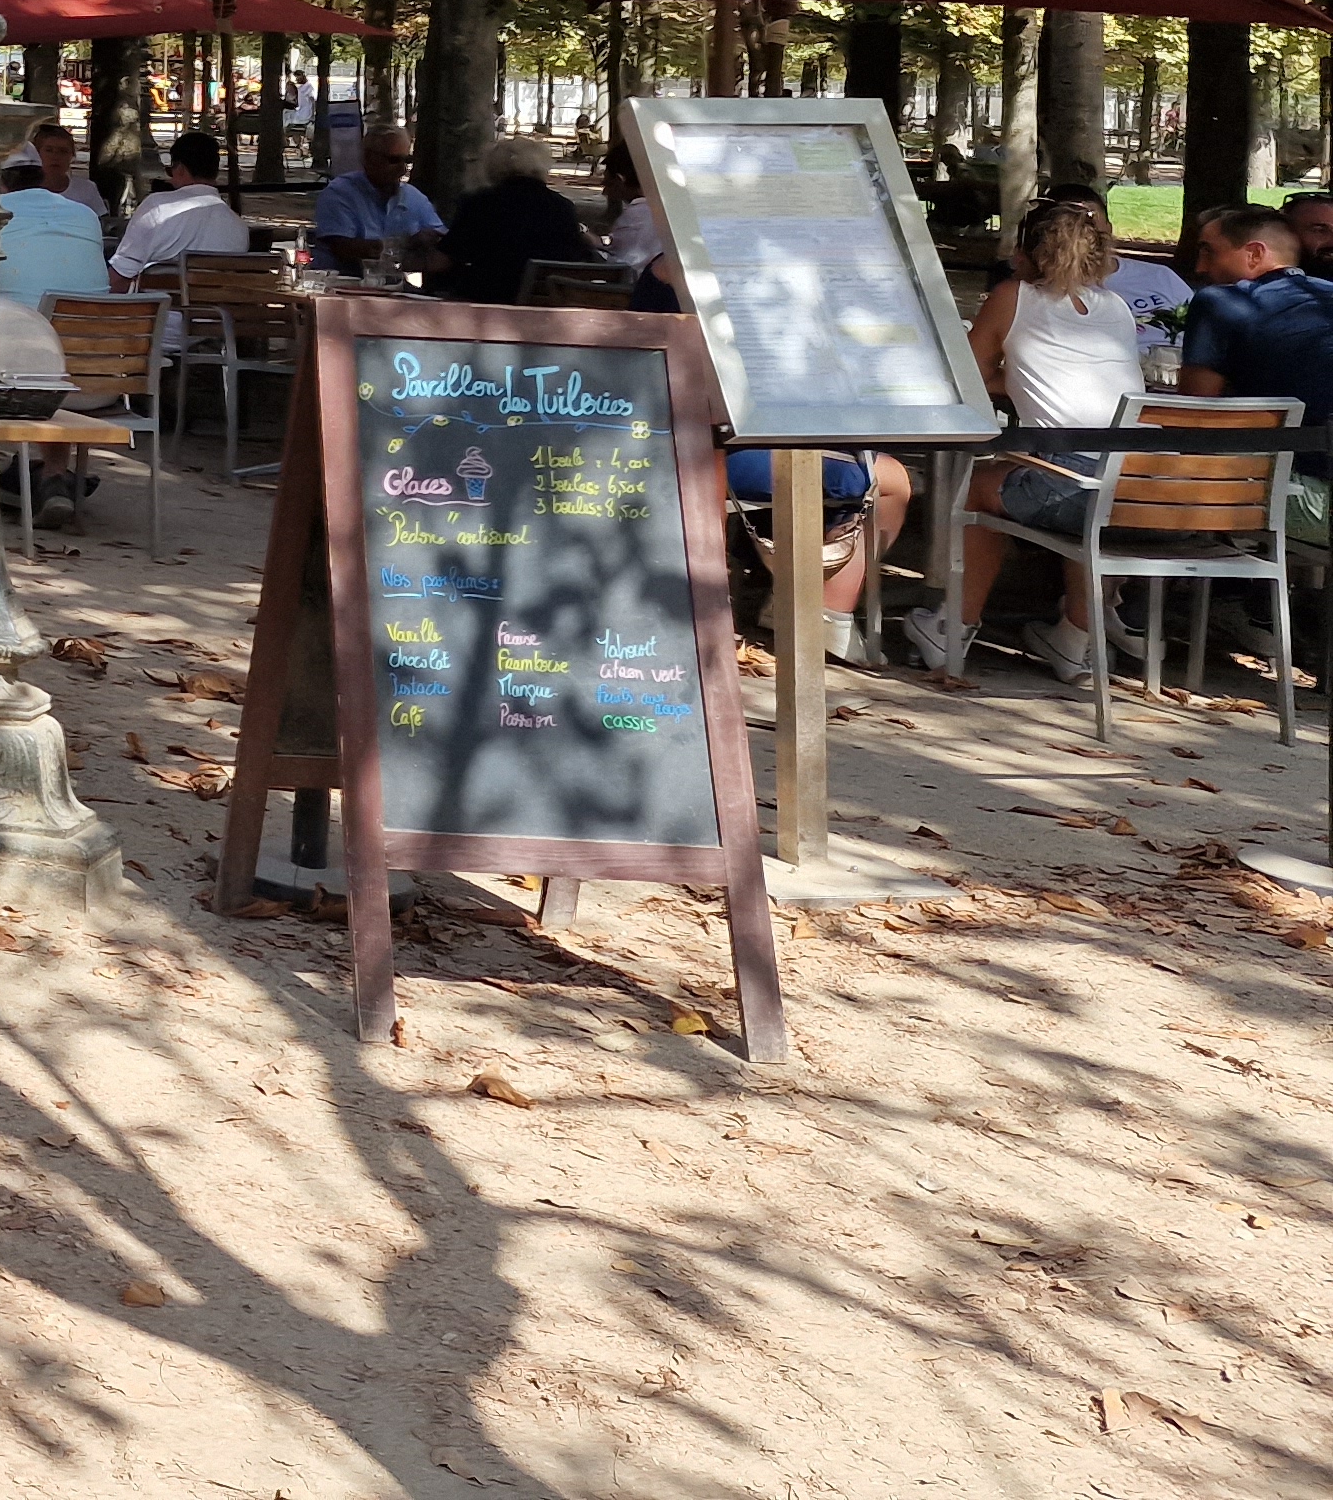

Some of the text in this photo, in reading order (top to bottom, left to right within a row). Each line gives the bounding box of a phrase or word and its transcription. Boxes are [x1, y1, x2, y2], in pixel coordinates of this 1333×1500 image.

[392, 352, 634, 417] Pavillon des Tuileries
[529, 445, 545, 469] 1
[383, 466, 453, 496] Glaces
[533, 474, 546, 492] 2
[533, 497, 548, 515] 3
[381, 564, 412, 589] Nos
[386, 617, 443, 644] Vanille
[390, 701, 427, 738] Café
[499, 703, 558, 729] Passion
